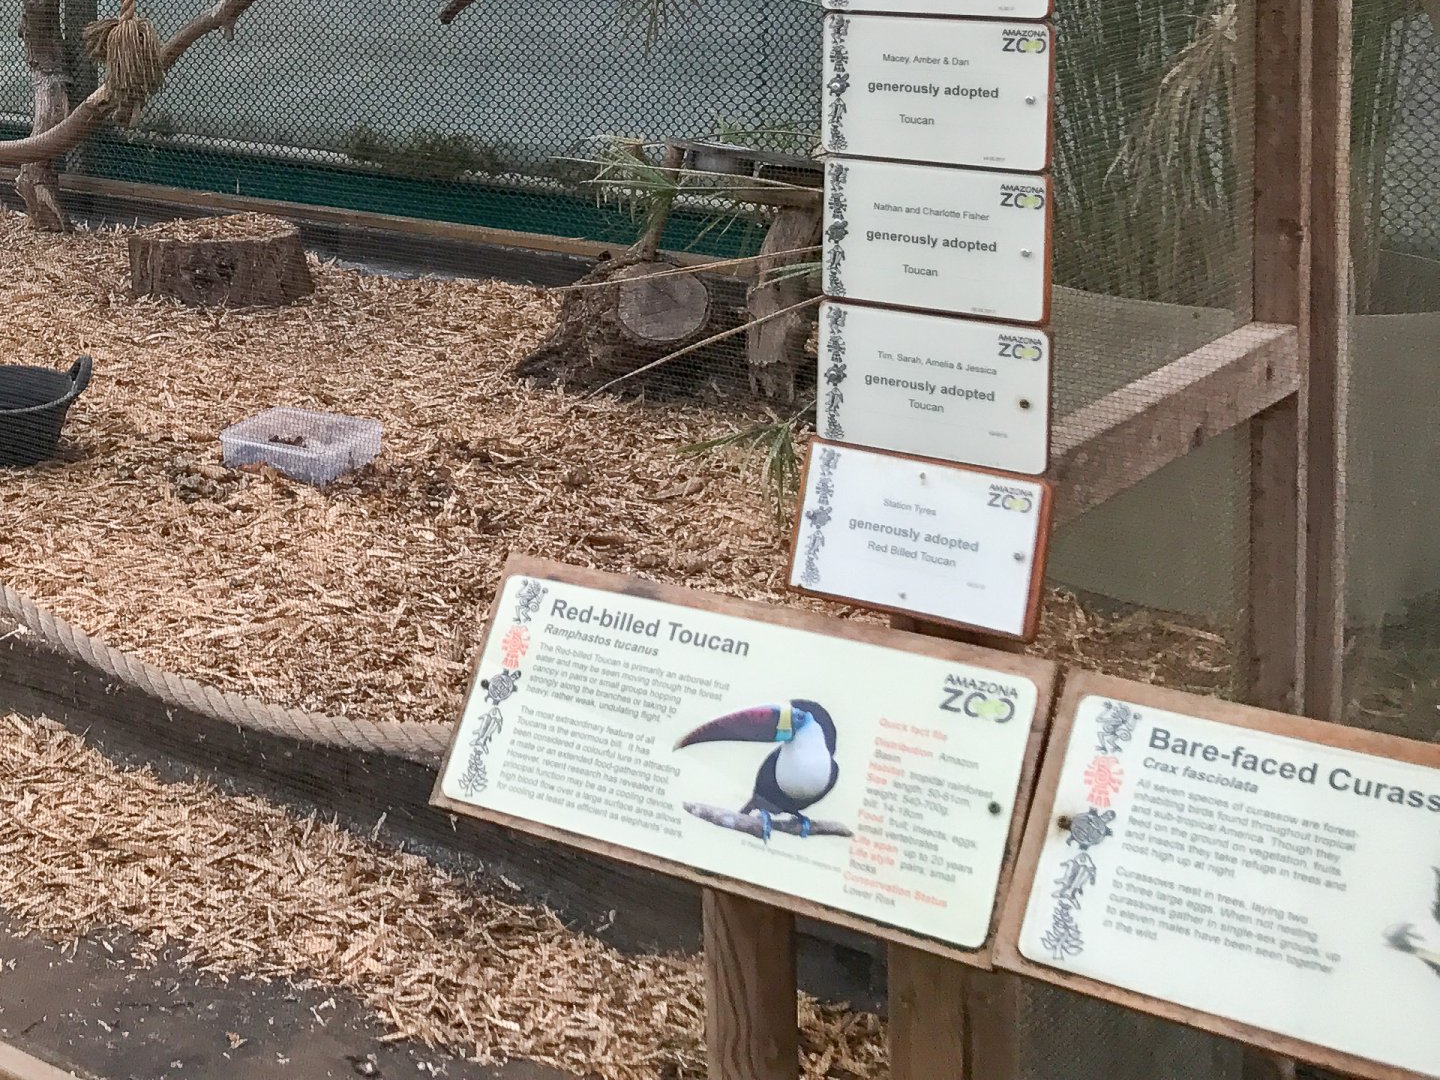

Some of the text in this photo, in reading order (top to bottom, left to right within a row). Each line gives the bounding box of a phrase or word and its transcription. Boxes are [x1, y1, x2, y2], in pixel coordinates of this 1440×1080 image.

[1001, 28, 1046, 38] AMAZONA
[912, 55, 941, 64] Amber
[942, 56, 950, 65] &
[951, 57, 969, 66] Dan
[867, 81, 999, 99] generously adopted
[898, 113, 934, 125] Toucan
[1000, 183, 1044, 194] AMAZONA
[873, 202, 990, 221] Nathan and Charlotte Fisher
[865, 230, 997, 252] generously adopted
[902, 264, 938, 276] Toucan
[997, 333, 1042, 346] AMAZONA
[924, 357, 955, 369] Amelia
[955, 361, 963, 370] &
[964, 362, 997, 375] Jessica
[864, 375, 995, 401] generously adopted
[908, 398, 944, 412] Toucan
[989, 483, 1032, 498] AMAZONA
[882, 498, 937, 516] Station Tyres
[848, 518, 980, 552] generously adopted
[866, 540, 956, 567] Red Billed Toucan
[549, 598, 750, 657] Red-billed Toucan
[544, 623, 658, 656] Ramphastos tucanus
[944, 673, 1017, 698] AMAZONA
[1148, 726, 1319, 785] Bare-faced
[1143, 756, 1259, 793] Crax fasciolata
